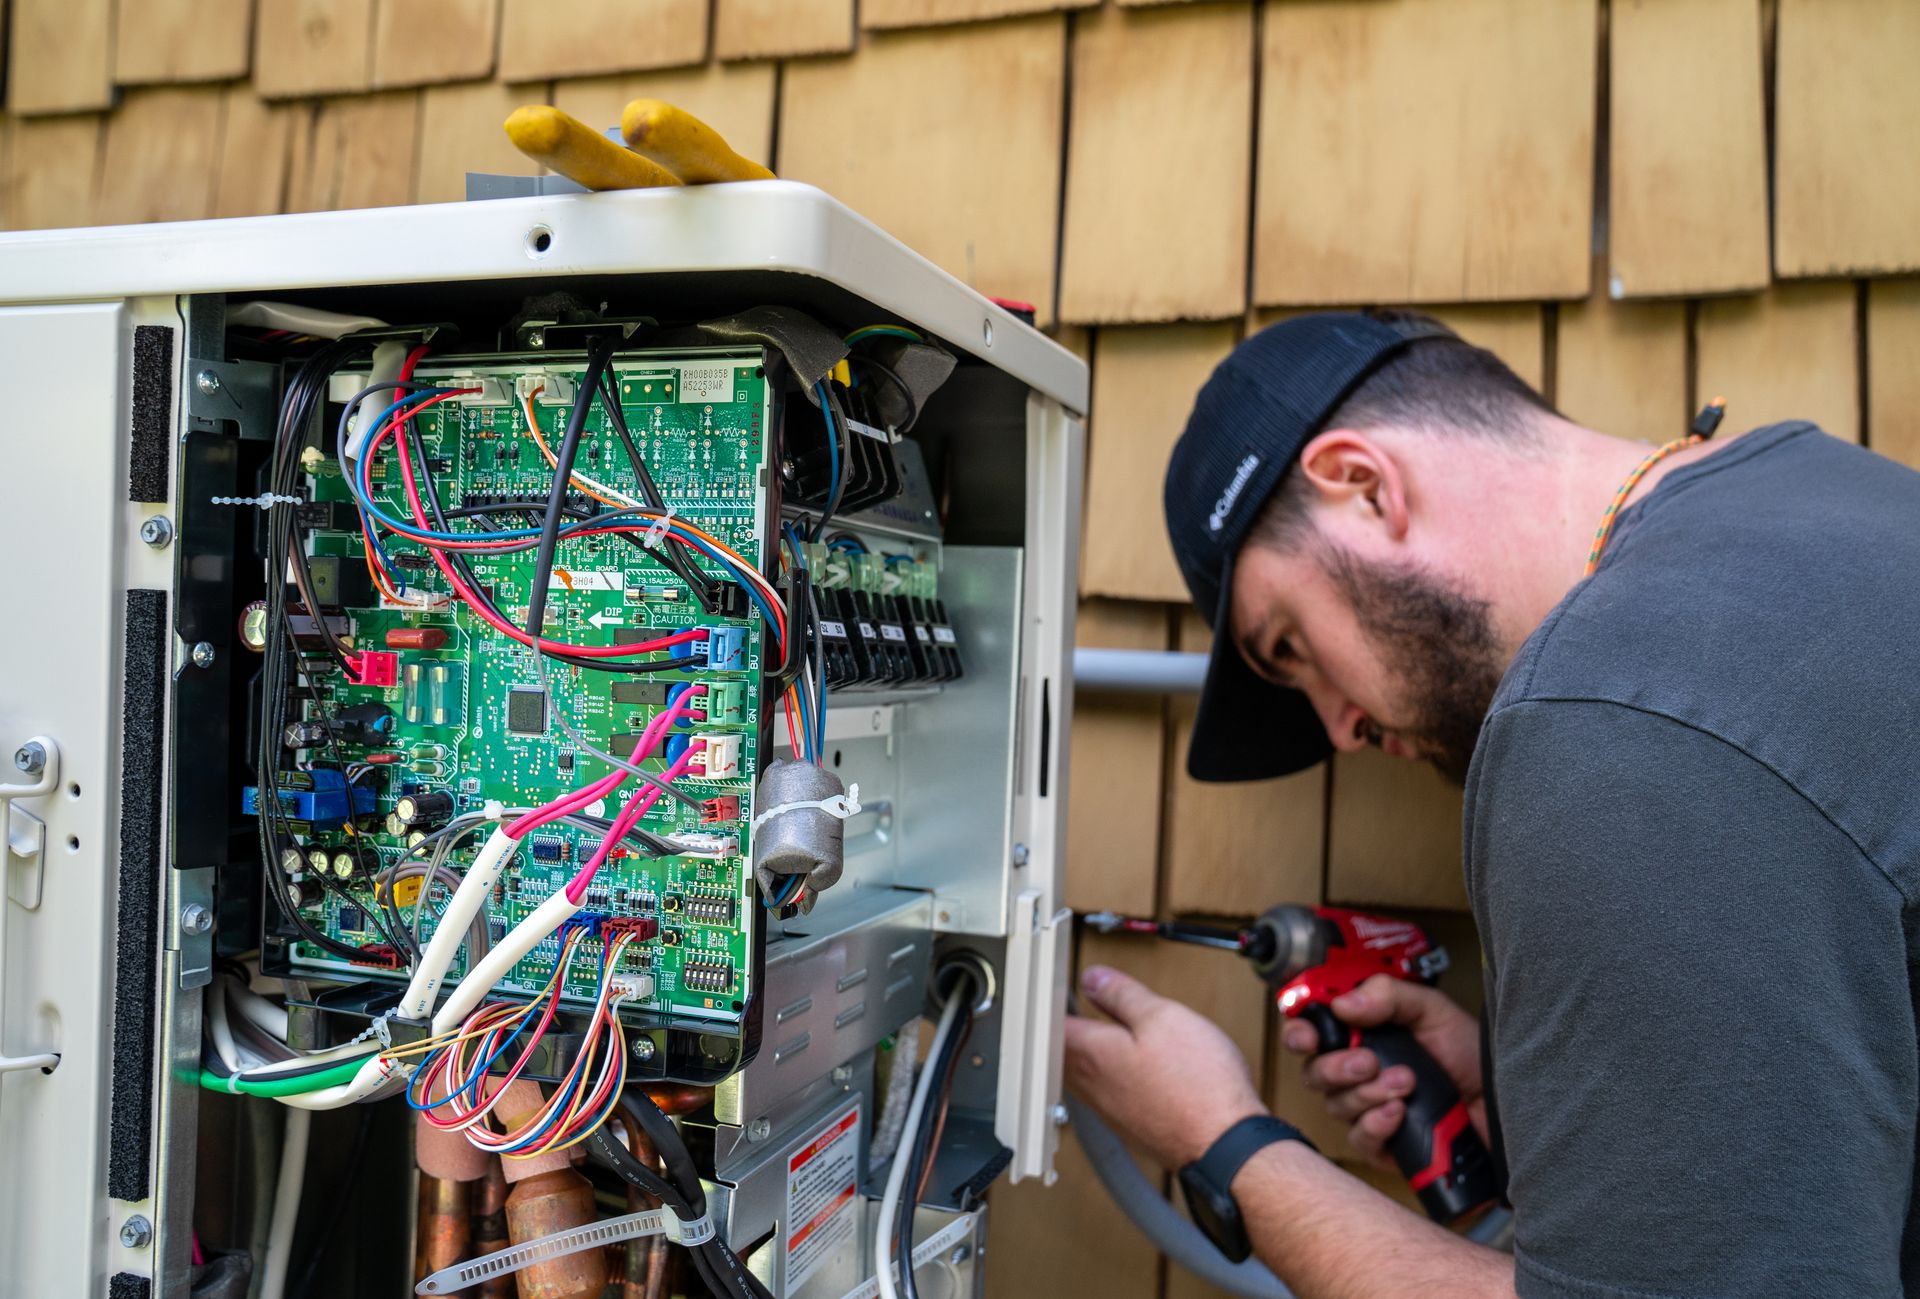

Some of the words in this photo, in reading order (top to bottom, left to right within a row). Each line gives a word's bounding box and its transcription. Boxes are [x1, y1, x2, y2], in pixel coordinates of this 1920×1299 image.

[474, 565, 486, 574] RD
[605, 607, 623, 616] DIP
[752, 605, 760, 619] BK
[653, 614, 697, 625] CAUTION
[750, 654, 759, 670] BU
[384, 688, 391, 702] PK
[748, 708, 758, 723] GN
[747, 757, 756, 773] WH
[619, 790, 633, 799] GN
[741, 807, 750, 822] RD
[714, 858, 728, 867] WH
[652, 946, 666, 956] RD
[523, 981, 536, 991] GN
[570, 987, 583, 995] YE
